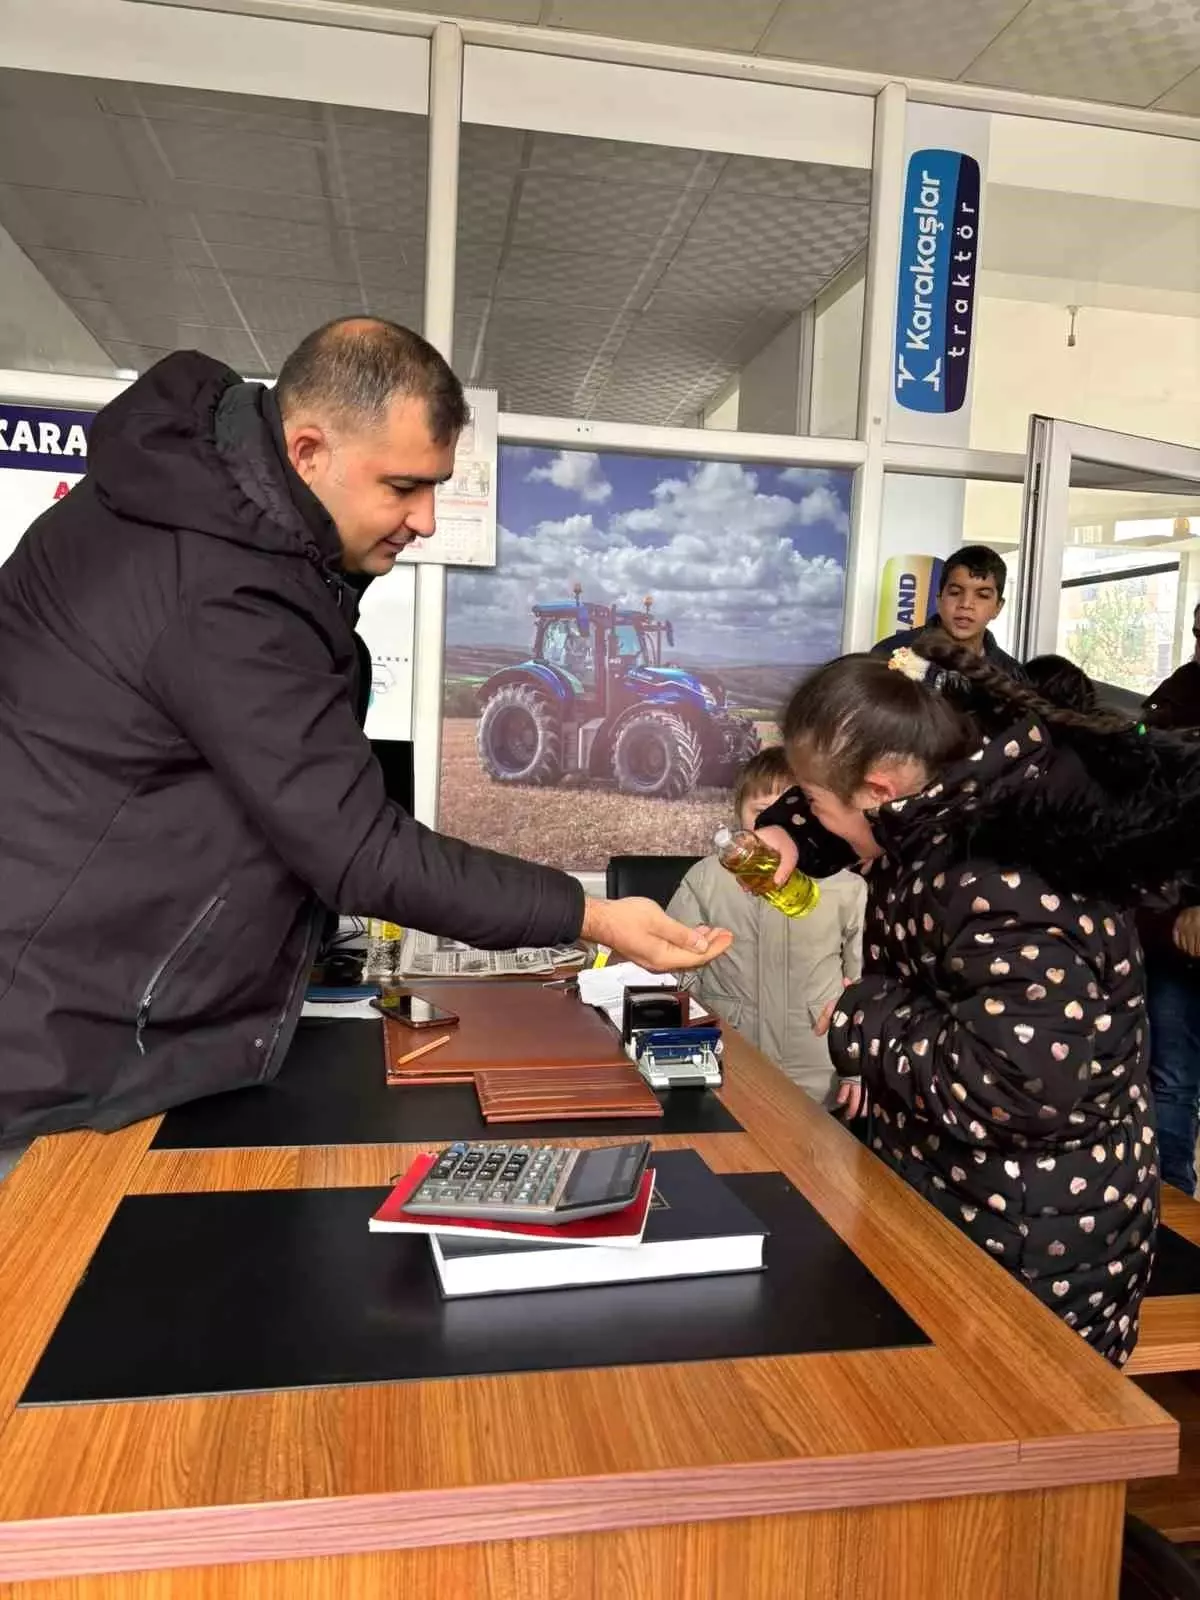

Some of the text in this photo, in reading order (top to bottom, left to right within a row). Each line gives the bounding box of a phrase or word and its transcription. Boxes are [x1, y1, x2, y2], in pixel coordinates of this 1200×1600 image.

[905, 170, 944, 350] Karakaşlar
[948, 202, 975, 357] traktör
[898, 574, 916, 624] AND
